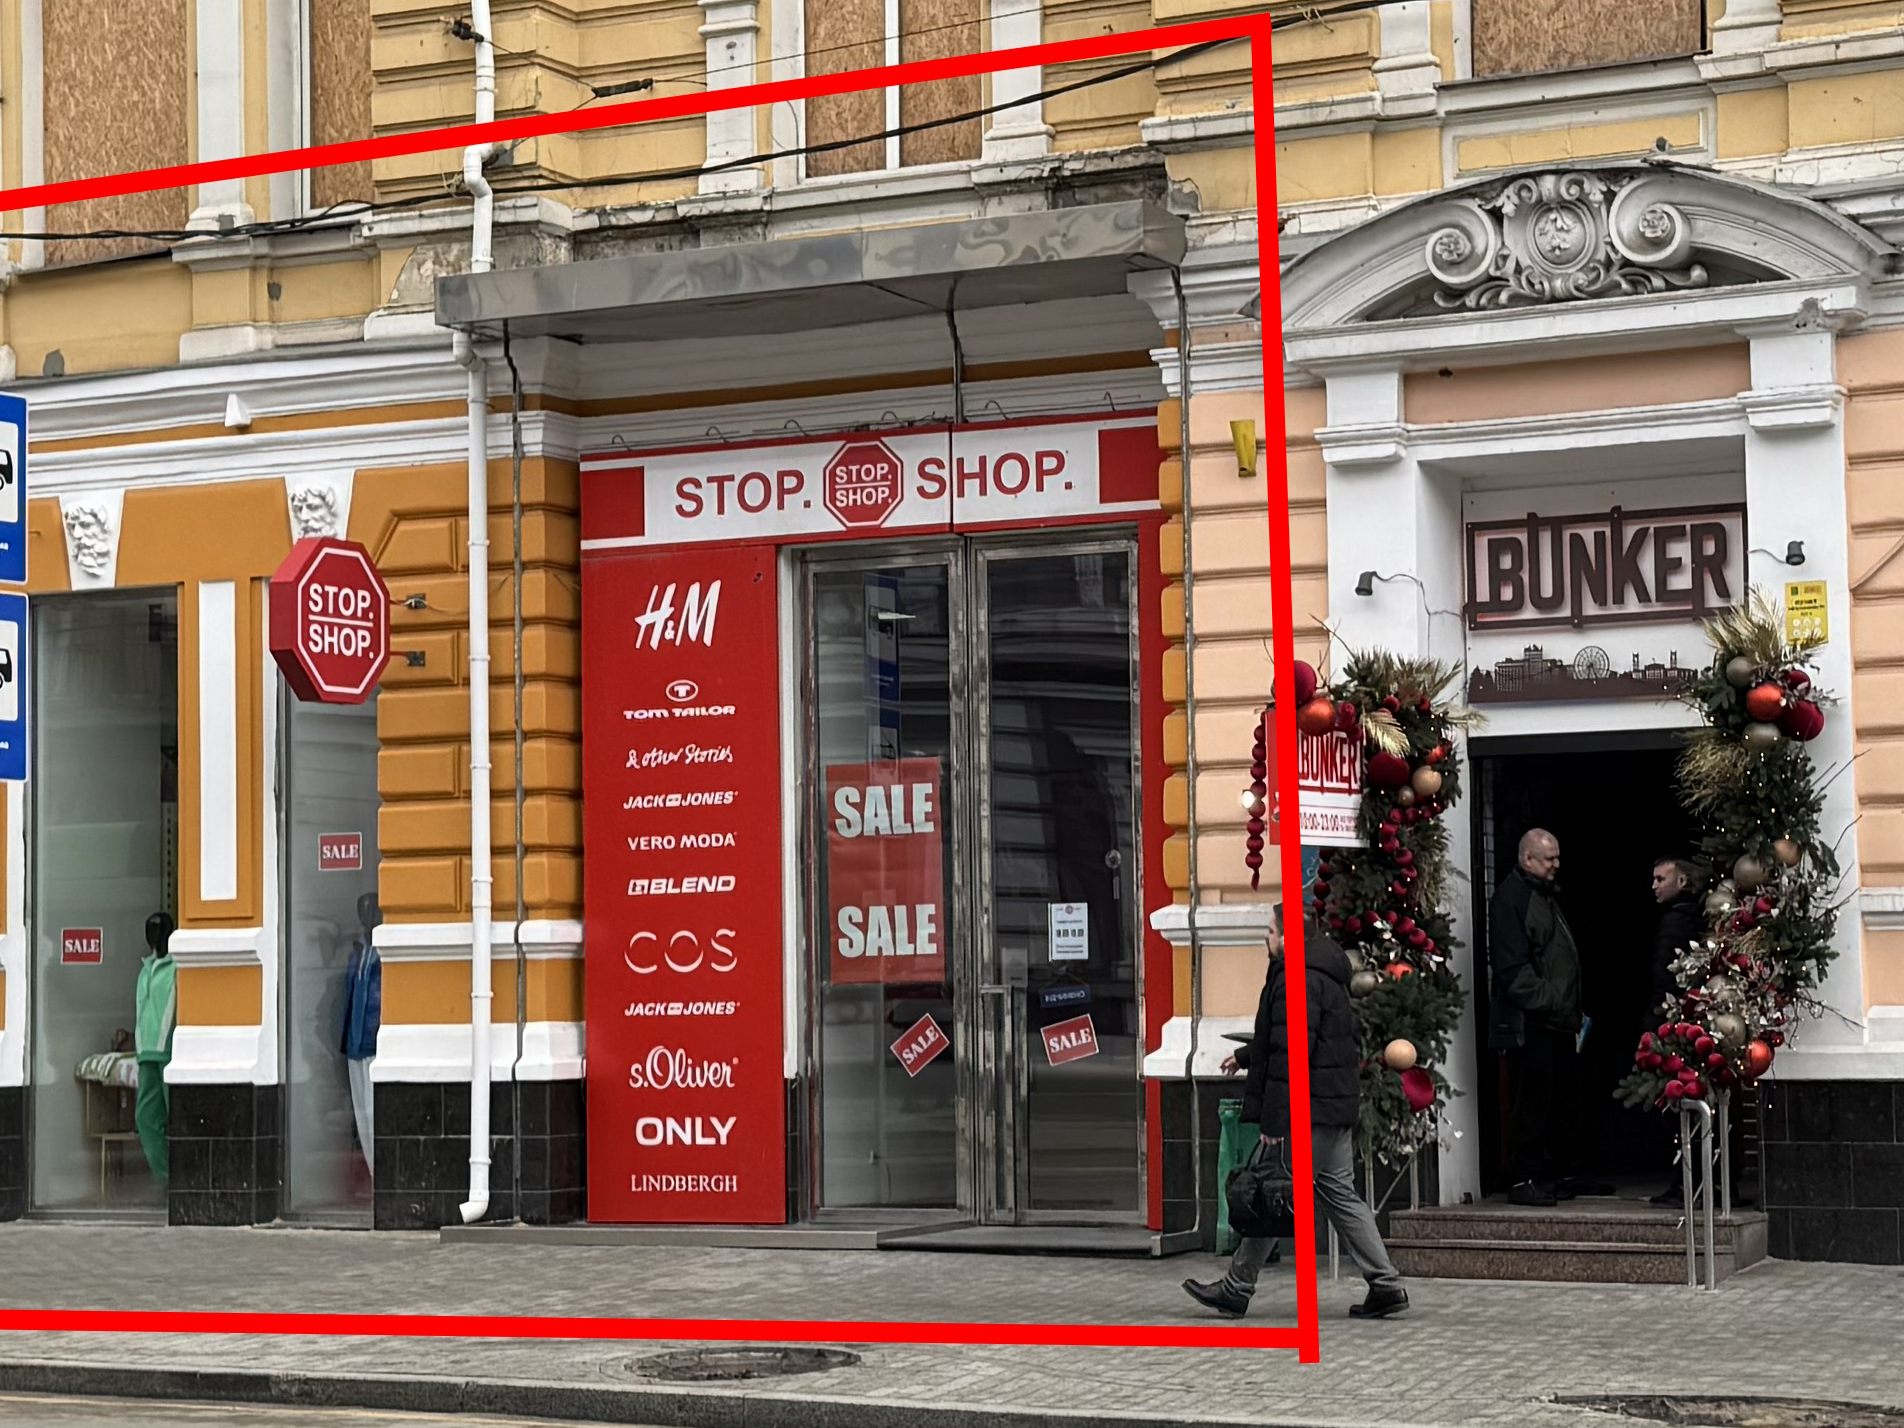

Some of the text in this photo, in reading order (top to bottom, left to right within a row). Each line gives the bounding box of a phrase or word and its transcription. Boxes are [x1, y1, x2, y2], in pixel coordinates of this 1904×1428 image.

[1487, 517, 1732, 615] BUNKER
[634, 579, 722, 650] H&M
[623, 705, 736, 720] TOM TAILOR
[642, 747, 683, 768] other
[834, 783, 935, 838] SALE
[322, 844, 359, 859] SALE
[627, 832, 736, 851] VERO MODA
[650, 875, 736, 895] BLEND
[837, 904, 937, 958] SALE
[64, 939, 100, 953] SALE
[624, 928, 738, 974] COS
[901, 1025, 940, 1066] SALE
[1049, 1028, 1093, 1054] SALE
[629, 1045, 736, 1090] s.Oliver
[635, 1116, 737, 1146] ONLY
[631, 1174, 738, 1193] LINDBERGH
